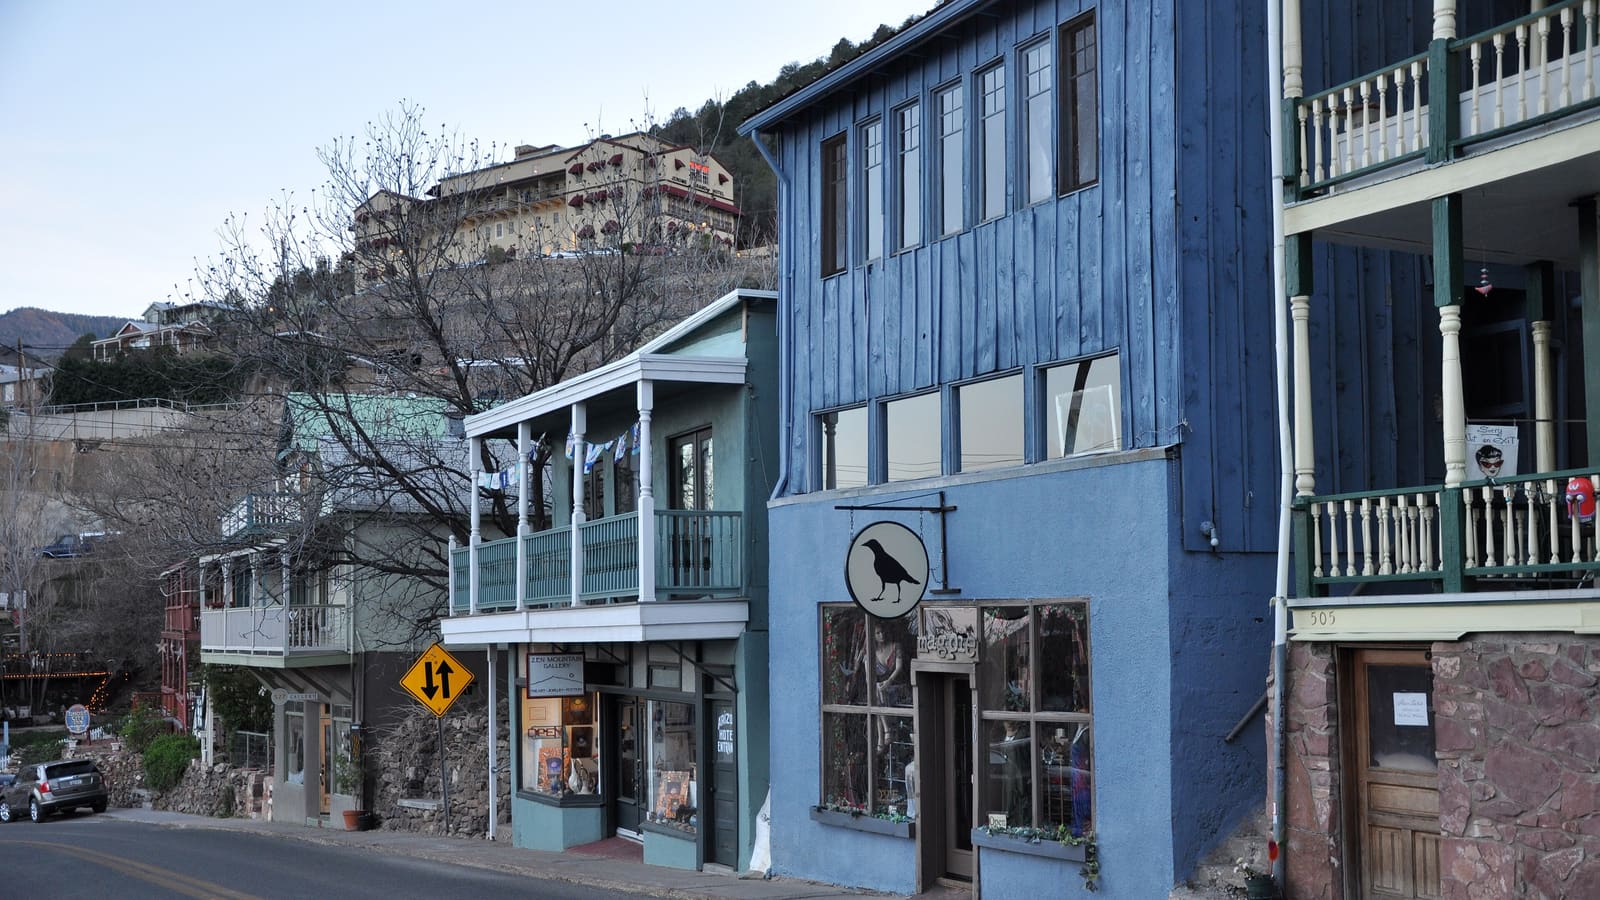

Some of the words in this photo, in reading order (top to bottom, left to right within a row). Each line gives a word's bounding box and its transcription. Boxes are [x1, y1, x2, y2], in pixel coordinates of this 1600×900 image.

[1477, 425, 1503, 437] Sorry
[1311, 610, 1336, 626] 505
[917, 631, 977, 660] magpie
[528, 727, 562, 737] OPEN
